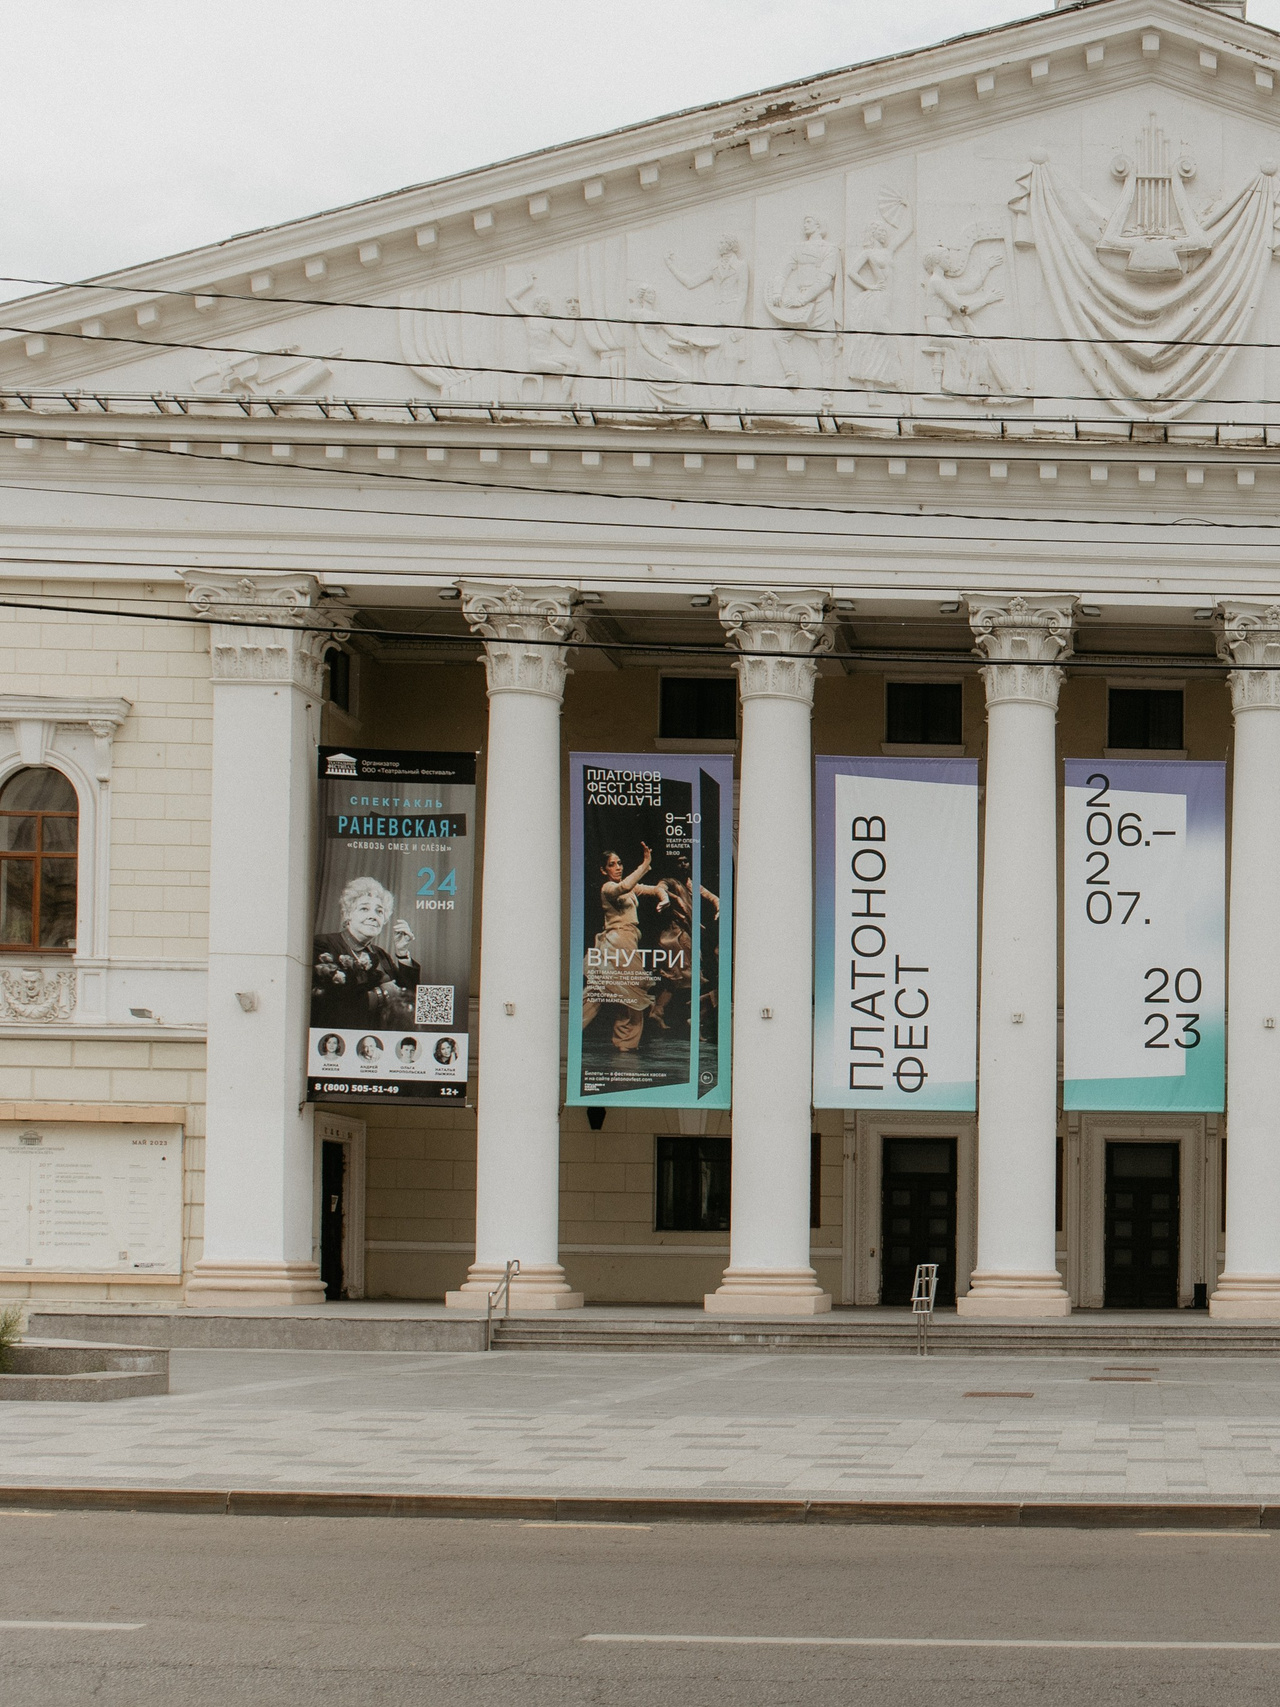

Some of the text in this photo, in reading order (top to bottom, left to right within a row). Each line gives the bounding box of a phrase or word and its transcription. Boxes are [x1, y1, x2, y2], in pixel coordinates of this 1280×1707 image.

[587, 769, 662, 782] ПЛАТОНОВ
[587, 781, 625, 794] ФЕСТ
[627, 782, 662, 794] FEST
[1085, 773, 1111, 808] 2
[350, 796, 444, 809] СПЕКТАКЛЬ
[587, 794, 662, 806] PLATONOV
[338, 816, 458, 838] РАНЕВСКАЯ:
[665, 825, 687, 836] 06.
[347, 841, 452, 852] «СКВОЗЬ СМЕХ И СЛЁЗЫ»
[1085, 850, 1111, 886] 2
[416, 866, 458, 896] 24
[416, 900, 455, 910] ИЮНЯ
[1085, 890, 1151, 925] 07.
[587, 948, 685, 968] ВНУТРИ
[849, 815, 887, 1091] ПЛАТОНОВ
[1144, 967, 1202, 1004] 20
[892, 954, 930, 1094] ФЕСТ
[1144, 1013, 1202, 1050] 23
[315, 1083, 400, 1094] 8 (800) 505-51-49
[440, 1087, 459, 1096] 12+
